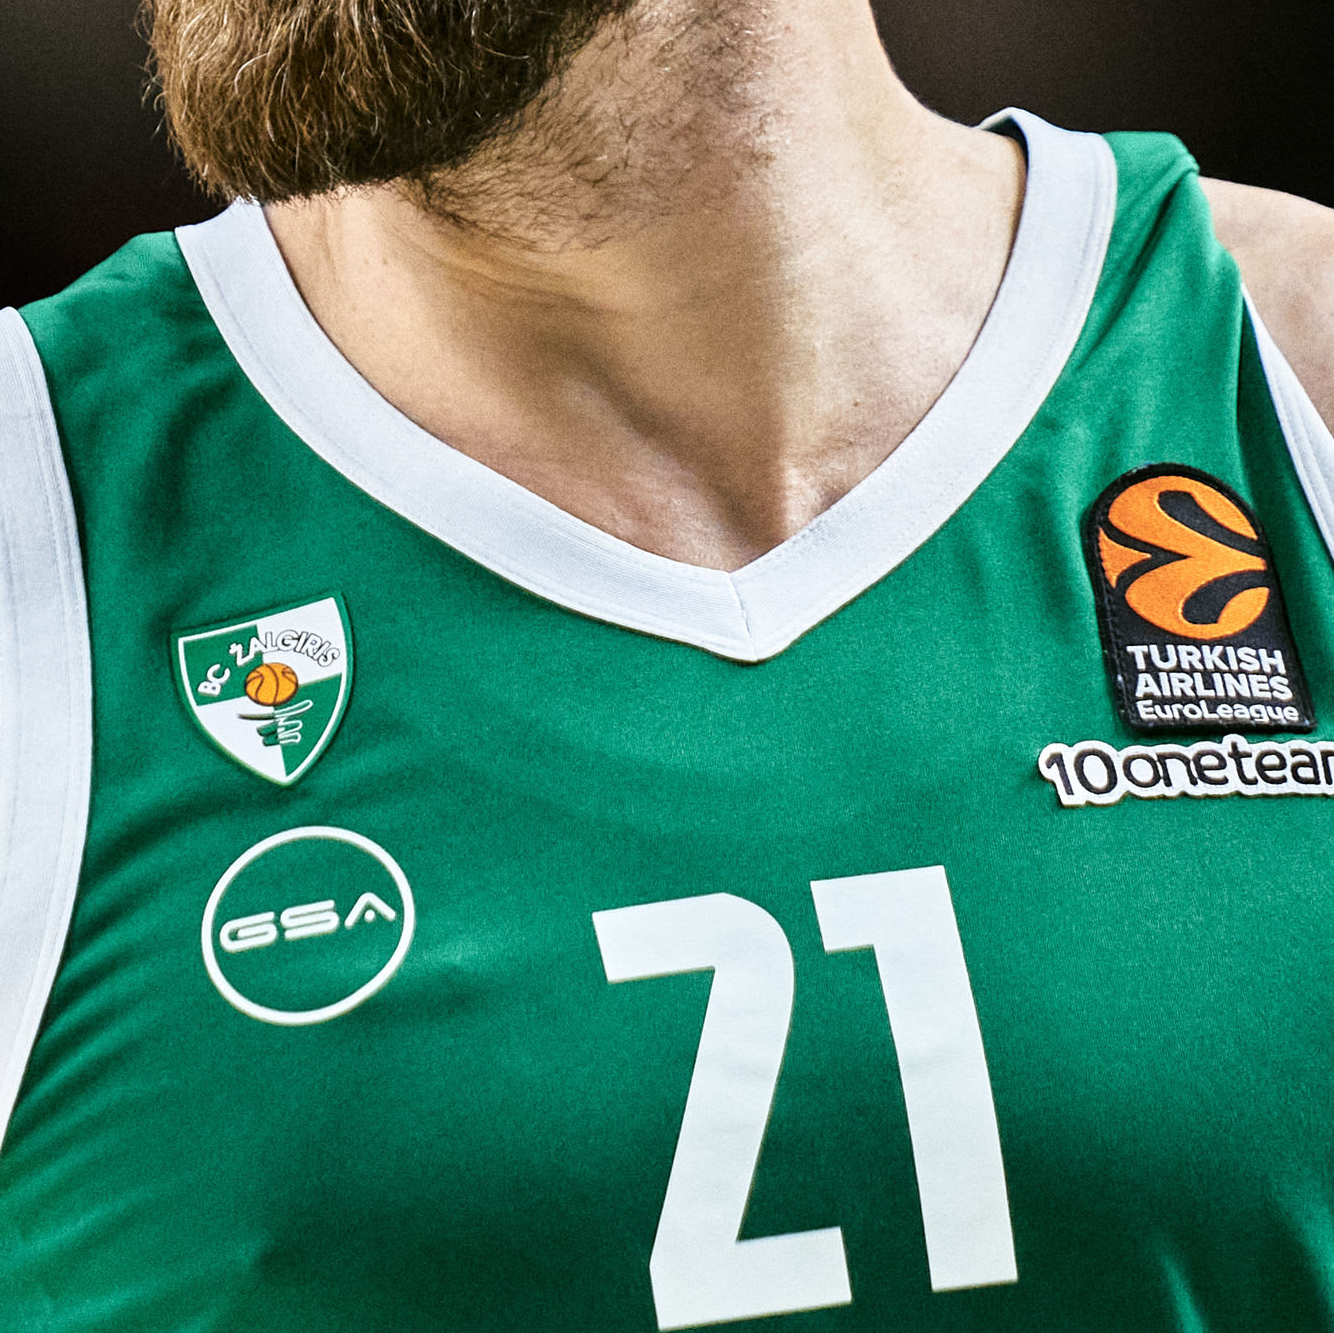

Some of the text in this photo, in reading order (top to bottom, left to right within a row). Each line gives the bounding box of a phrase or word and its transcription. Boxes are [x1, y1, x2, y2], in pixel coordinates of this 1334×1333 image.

[1126, 644, 1286, 674] TURKISH
[197, 663, 231, 697] BC
[1135, 672, 1293, 700] AIRLINES
[1136, 699, 1299, 723] EuroLeague
[219, 892, 396, 954] GSA
[591, 864, 1019, 1331] 21
